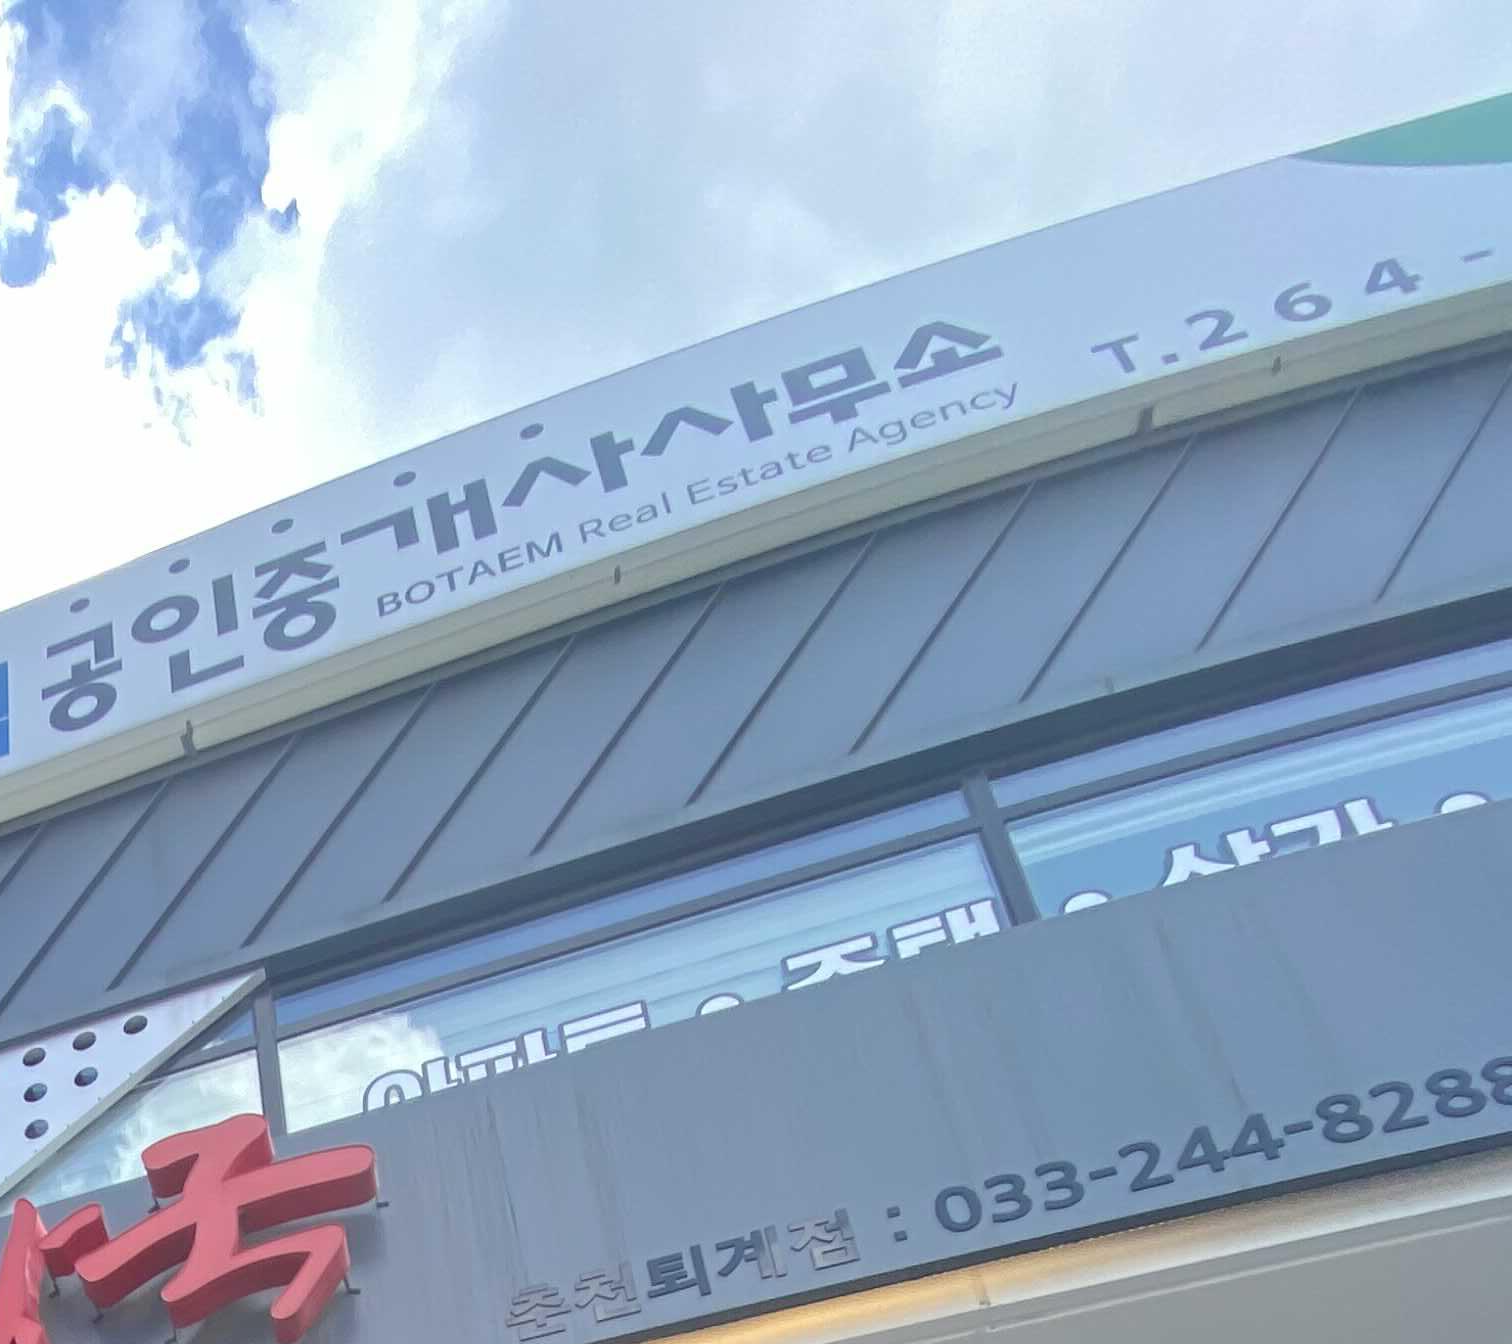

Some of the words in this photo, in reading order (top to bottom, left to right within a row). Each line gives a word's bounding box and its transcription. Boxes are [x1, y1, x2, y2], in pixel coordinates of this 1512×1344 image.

[41, 320, 1003, 732] 공인중개사사무소
[377, 531, 564, 618] BOTAEM
[579, 493, 671, 545] Real
[686, 441, 834, 506] Estate
[847, 382, 1019, 453] Agency
